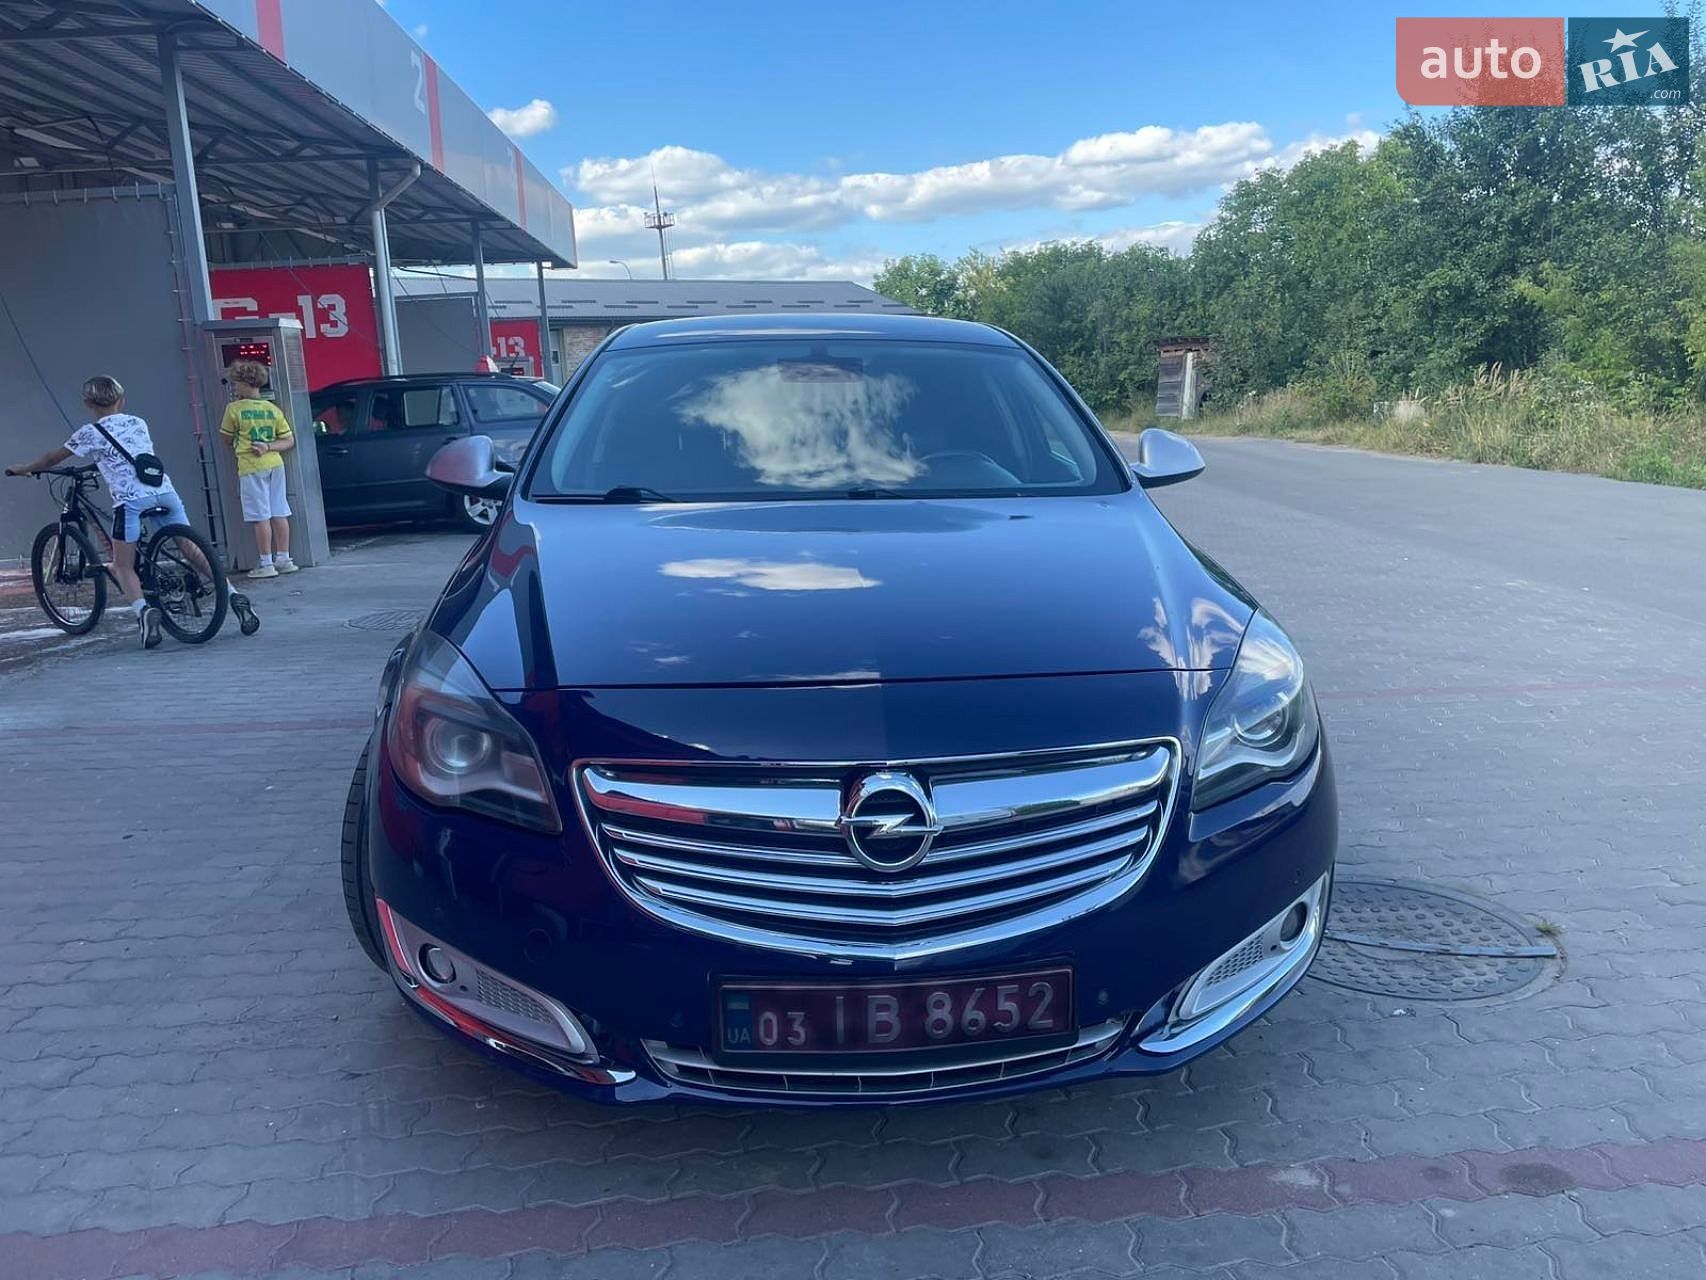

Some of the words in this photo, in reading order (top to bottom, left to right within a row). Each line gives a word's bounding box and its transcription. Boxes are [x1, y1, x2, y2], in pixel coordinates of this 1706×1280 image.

[758, 1011, 807, 1047] 03
[925, 981, 1055, 1040] 8652
[727, 1027, 750, 1044] UA
